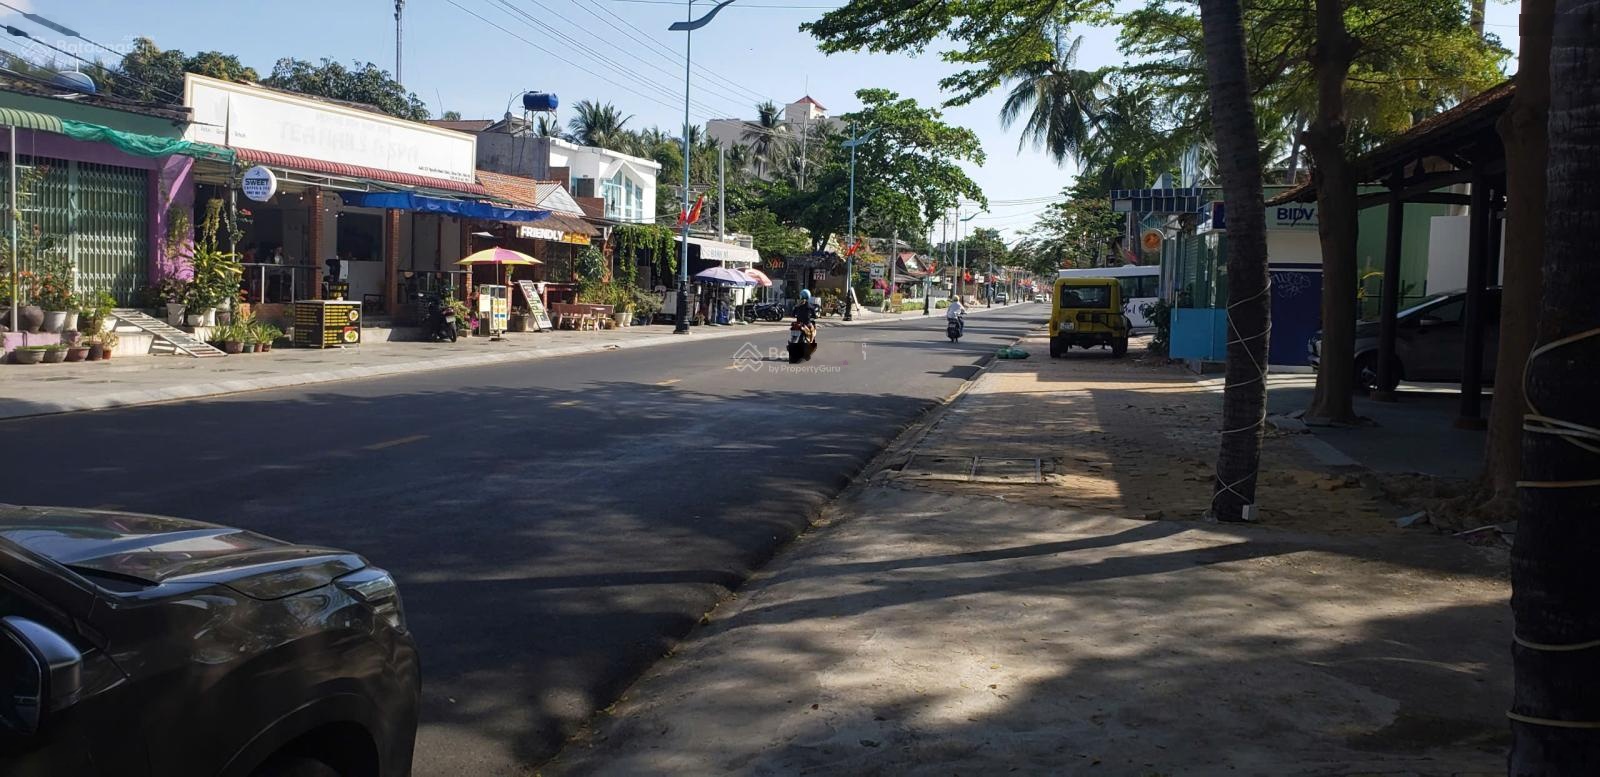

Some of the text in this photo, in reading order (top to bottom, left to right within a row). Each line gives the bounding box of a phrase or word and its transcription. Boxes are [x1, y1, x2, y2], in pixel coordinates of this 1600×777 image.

[245, 178, 269, 186] SWEET
[1277, 207, 1315, 221] BIDV
[520, 226, 564, 241] FRIENDLY
